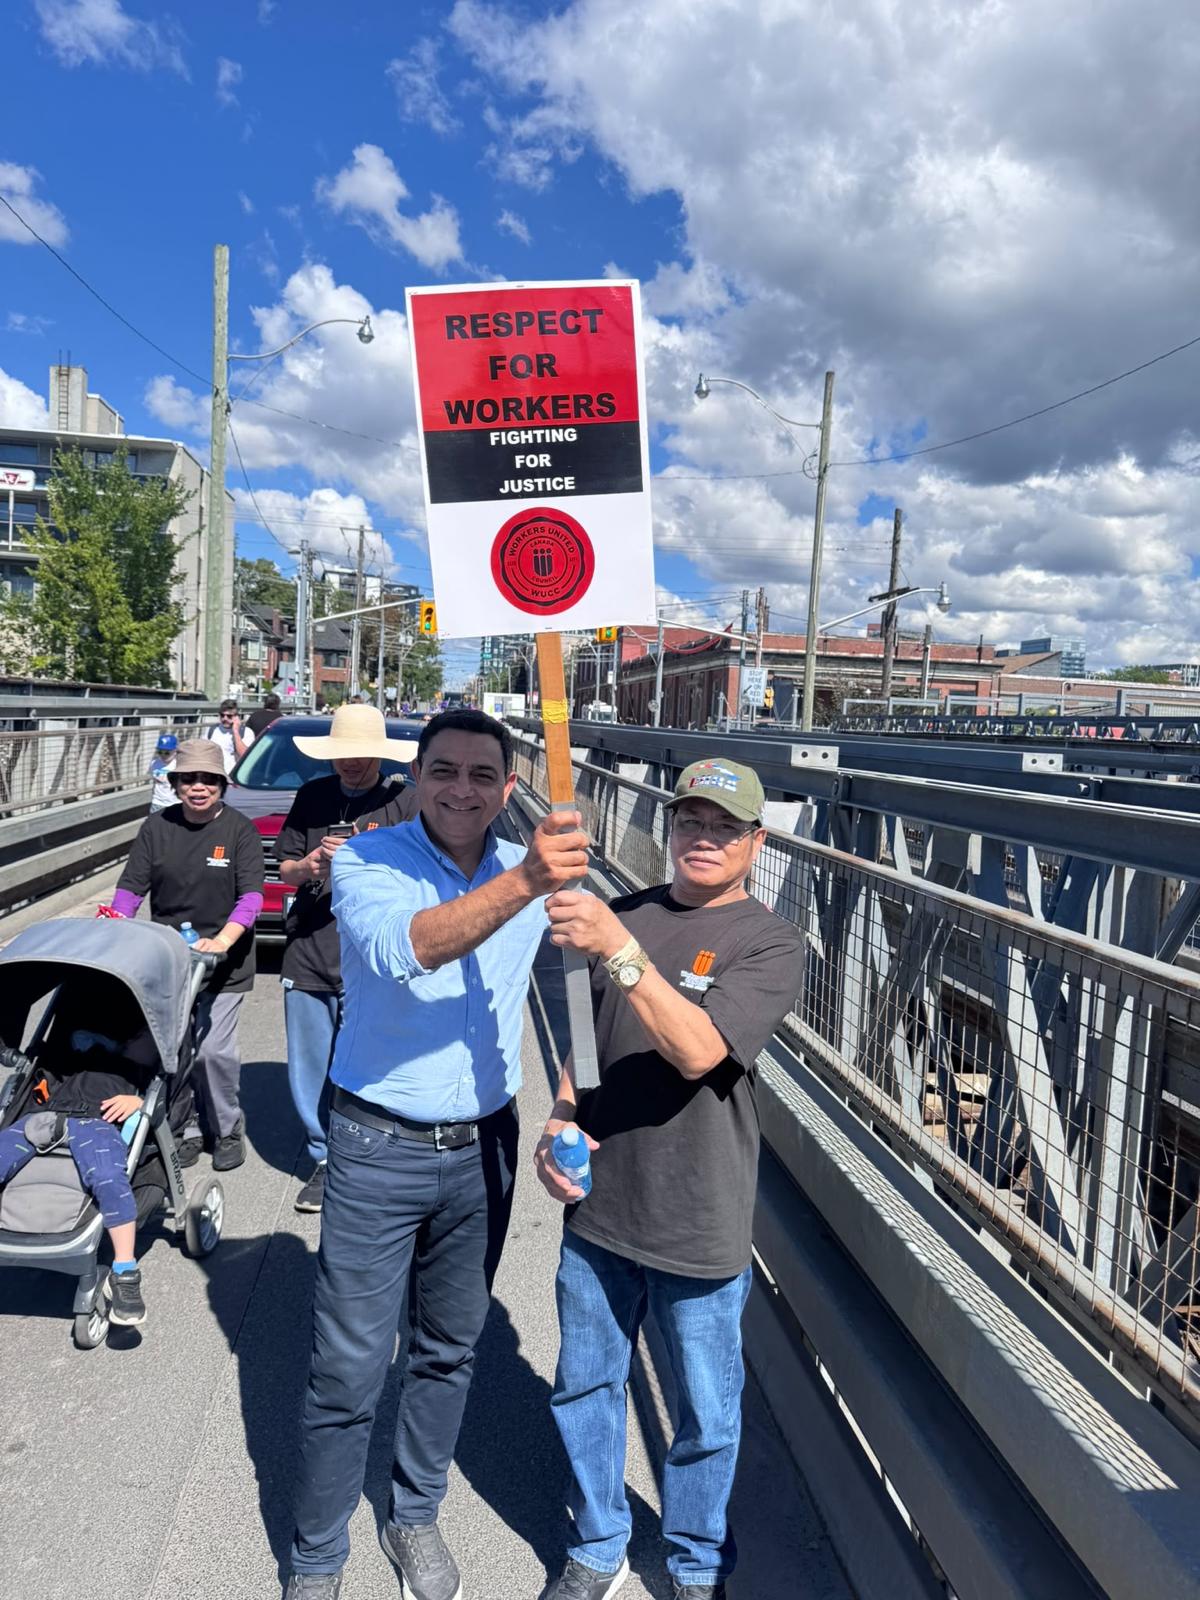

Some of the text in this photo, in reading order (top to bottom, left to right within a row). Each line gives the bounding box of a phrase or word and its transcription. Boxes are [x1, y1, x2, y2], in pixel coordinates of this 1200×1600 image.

[445, 309, 603, 340] RESPECT
[488, 353, 559, 380] FOR
[443, 392, 616, 425] WORKERS
[489, 427, 578, 446] FIGHTING
[514, 453, 552, 469] FOR
[499, 476, 576, 494] JUSTICE
[509, 526, 575, 556] WORKERS UNITED
[530, 540, 554, 548] CANADA
[531, 587, 561, 597] WUCC
[170, 1151, 185, 1195] BRAVO
